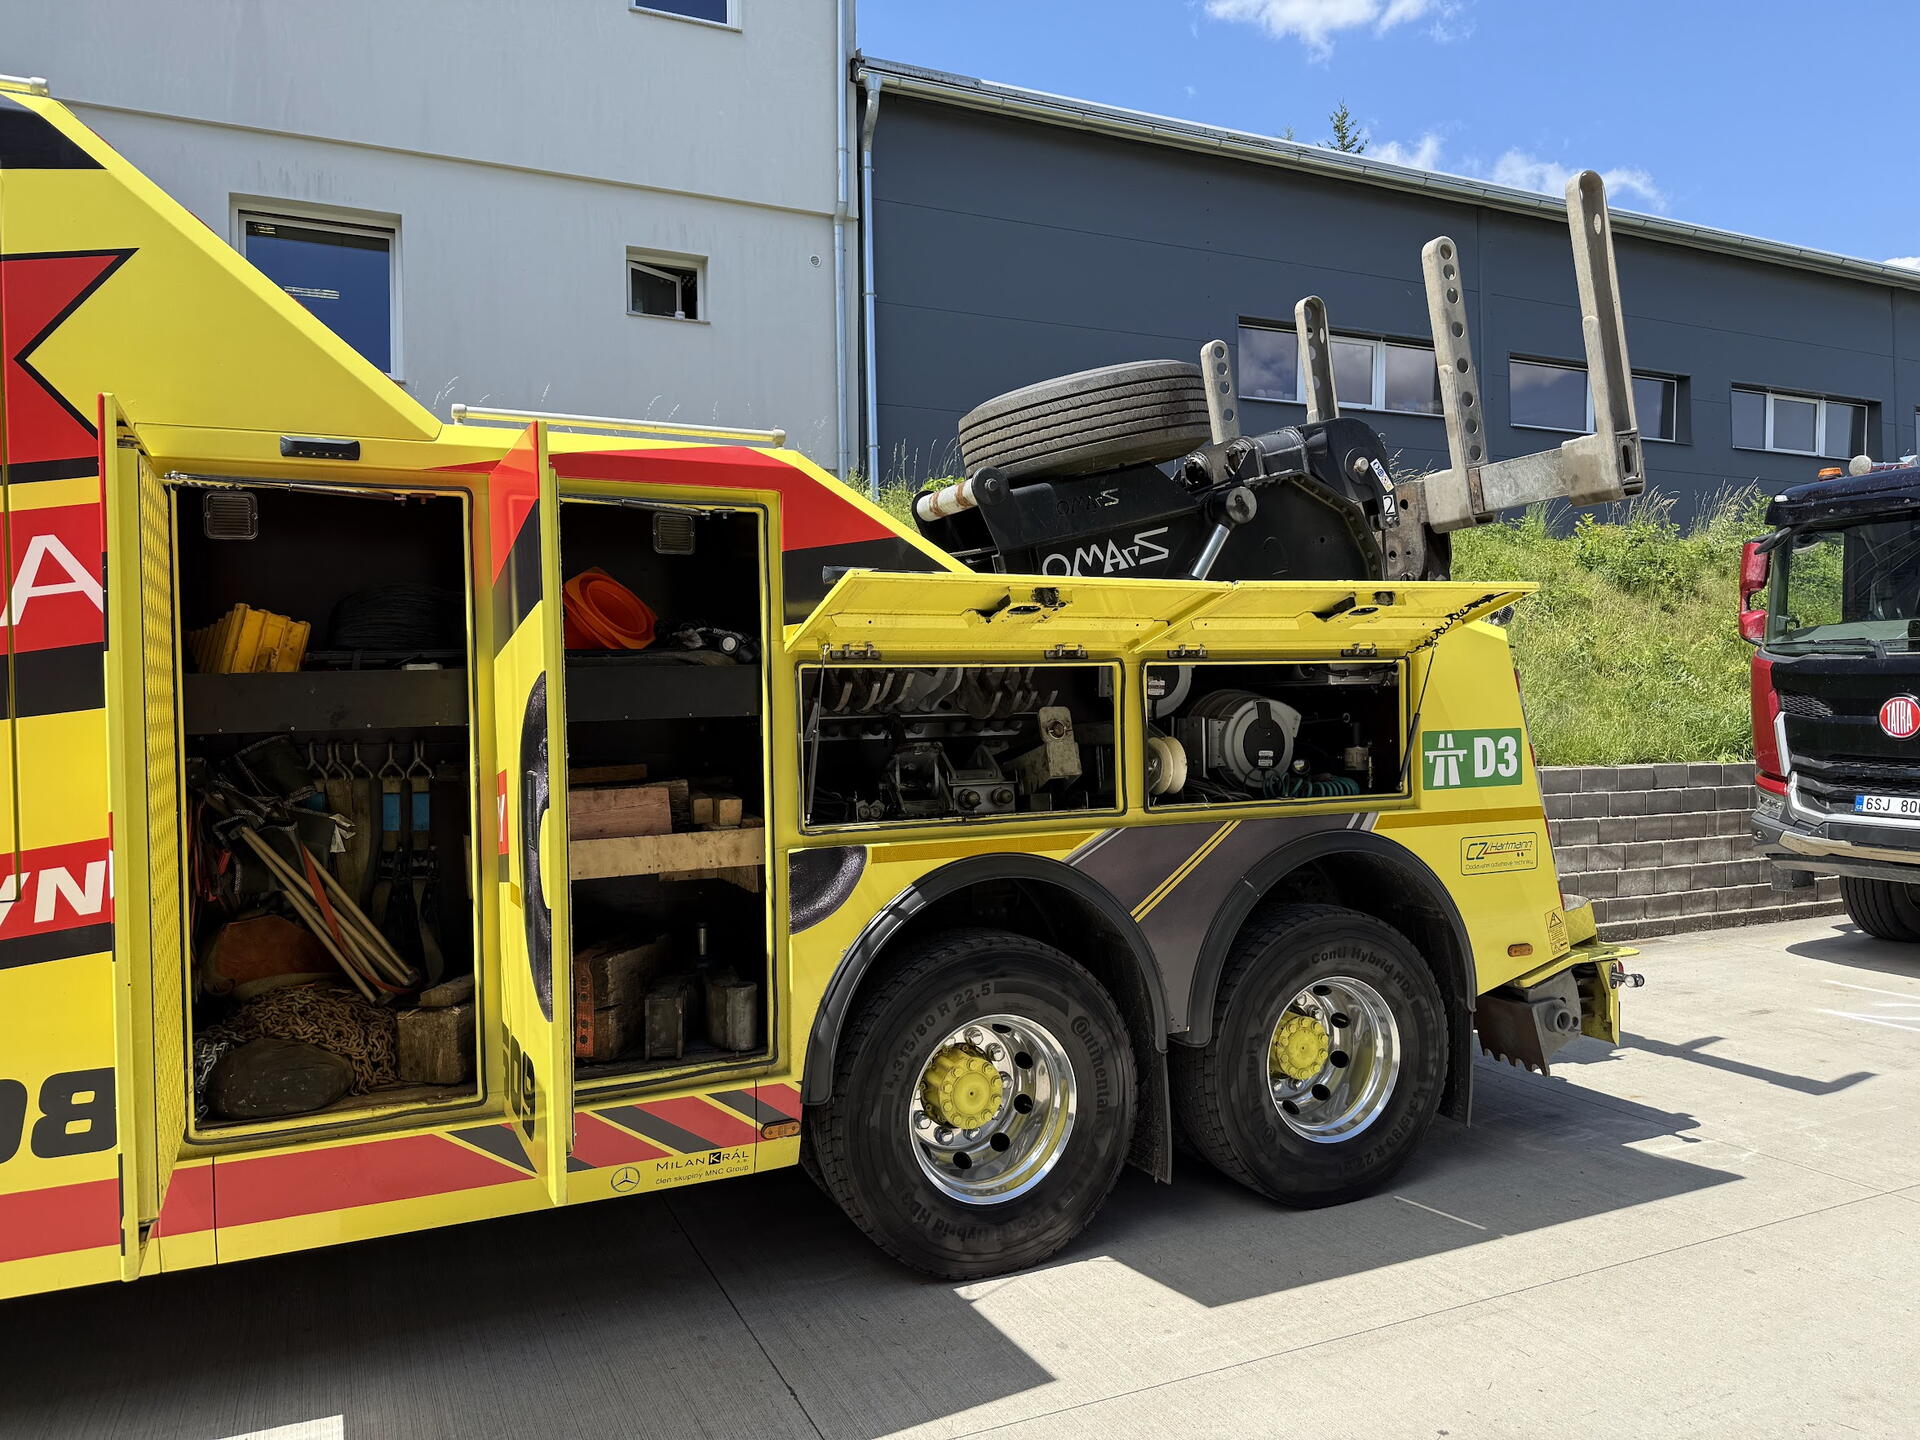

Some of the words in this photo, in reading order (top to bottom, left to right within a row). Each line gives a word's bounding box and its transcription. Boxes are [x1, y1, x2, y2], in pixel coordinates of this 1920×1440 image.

[1383, 496, 1395, 515] 2
[0, 534, 104, 627] A
[1886, 701, 1913, 735] TATRA
[1473, 736, 1518, 778] D3
[1866, 798, 1891, 811] 6SJ
[1466, 842, 1489, 861] CZ
[1489, 840, 1533, 851] Hartmann
[1311, 946, 1347, 964] Conti
[1350, 947, 1395, 974] Hybrid
[892, 1014, 936, 1072] 315/80
[937, 1002, 951, 1017] R
[953, 982, 992, 1008] 22.5
[1071, 1014, 1110, 1116] Continental
[656, 1157, 706, 1172] MILAN
[709, 1148, 749, 1165] KRÁL
[674, 1172, 703, 1181] skupiny
[704, 1168, 724, 1177] MNC
[725, 1165, 749, 1174] Group
